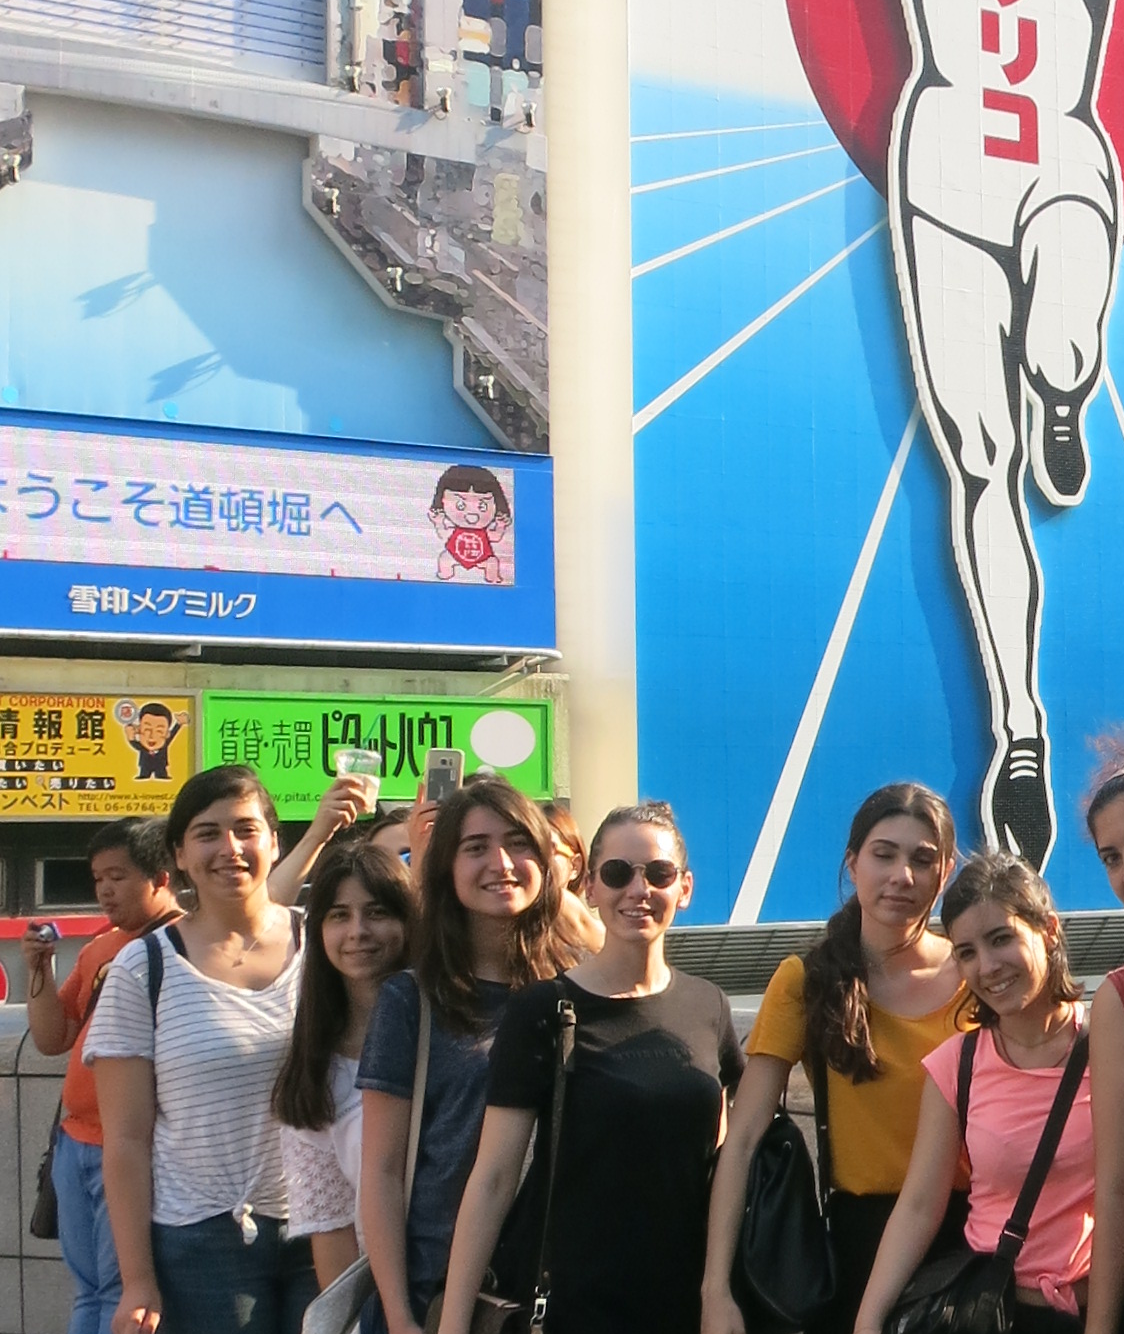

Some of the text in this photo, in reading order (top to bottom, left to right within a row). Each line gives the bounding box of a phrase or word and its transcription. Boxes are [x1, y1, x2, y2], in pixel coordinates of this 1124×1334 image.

[68, 584, 256, 620] 雪印メグミルク
[9, 695, 105, 708] CORPORATION
[78, 802, 99, 812] TEL
